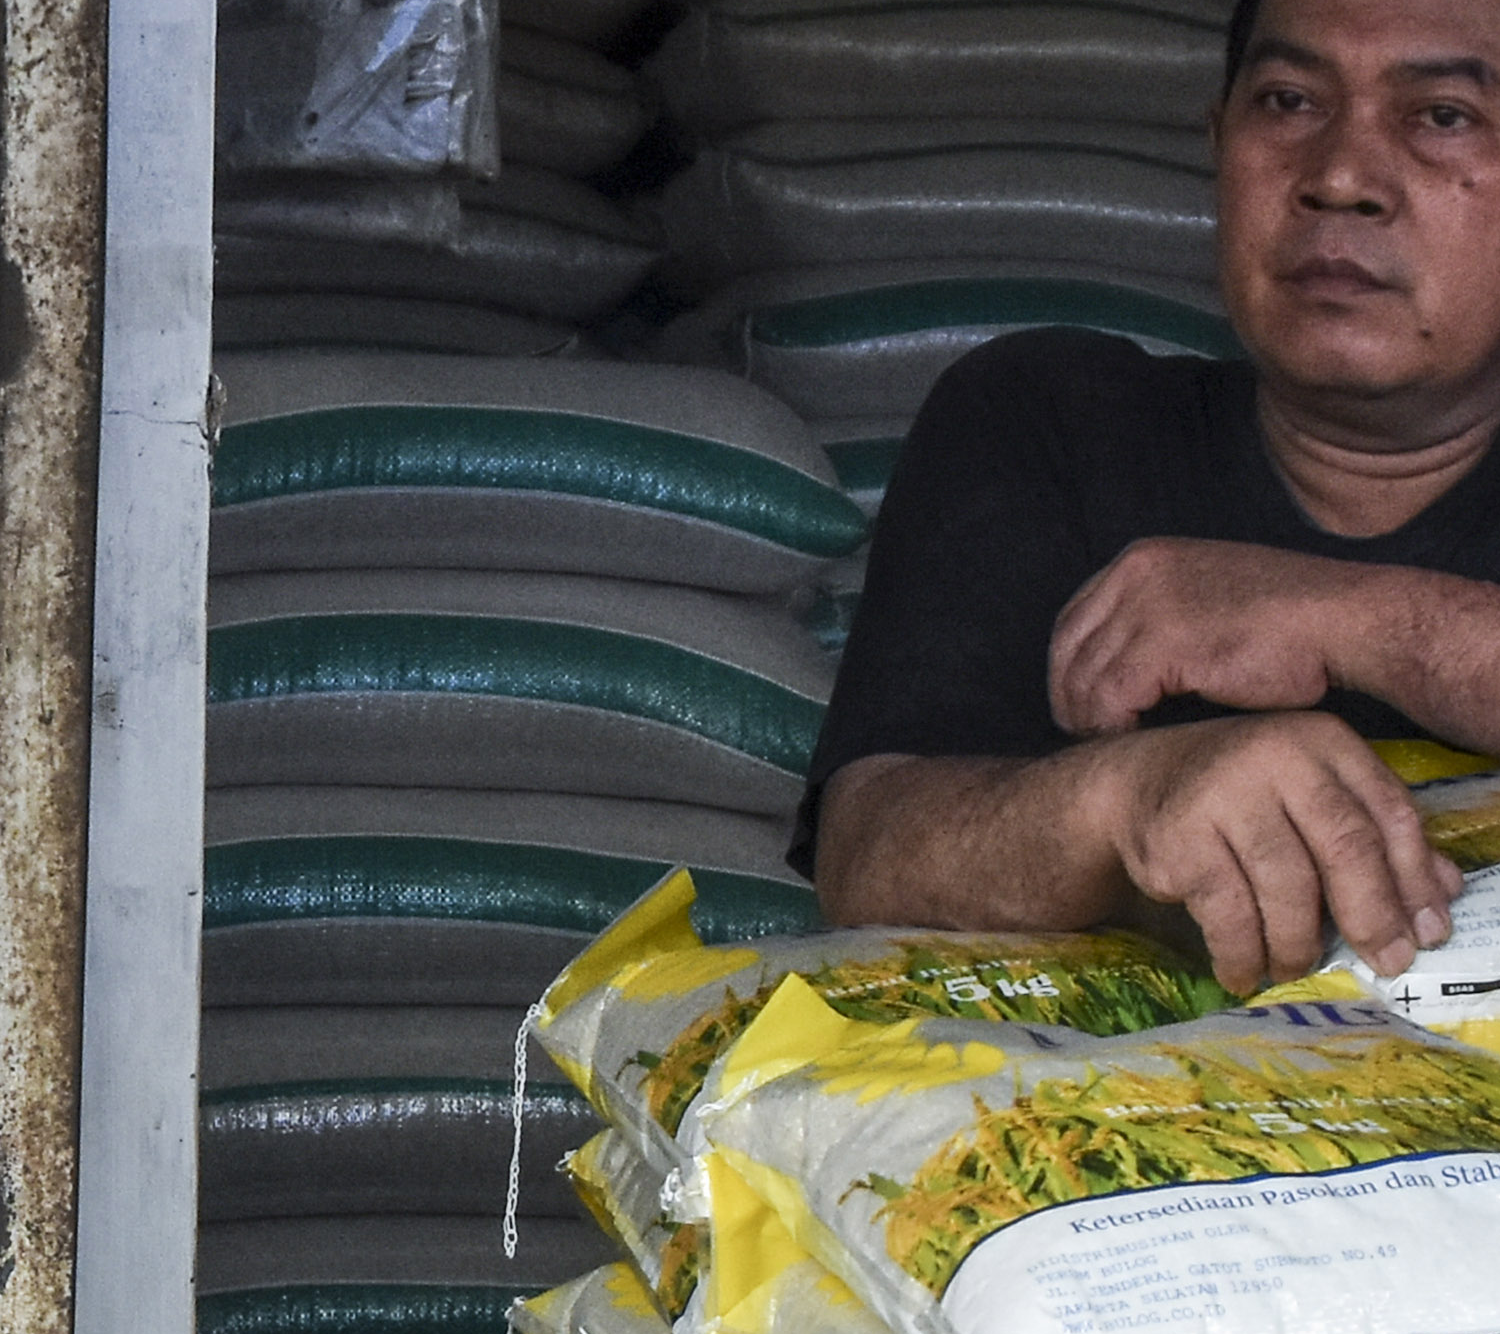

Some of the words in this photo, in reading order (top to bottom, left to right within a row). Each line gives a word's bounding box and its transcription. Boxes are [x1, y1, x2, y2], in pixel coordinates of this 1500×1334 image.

[945, 975, 991, 1002] 5
[996, 972, 1060, 998] kg
[1069, 1188, 1255, 1235] Ketersediaan
[1260, 1178, 1379, 1208] Pasokan
[1385, 1170, 1435, 1191] dan
[1341, 1243, 1399, 1263] NO.49
